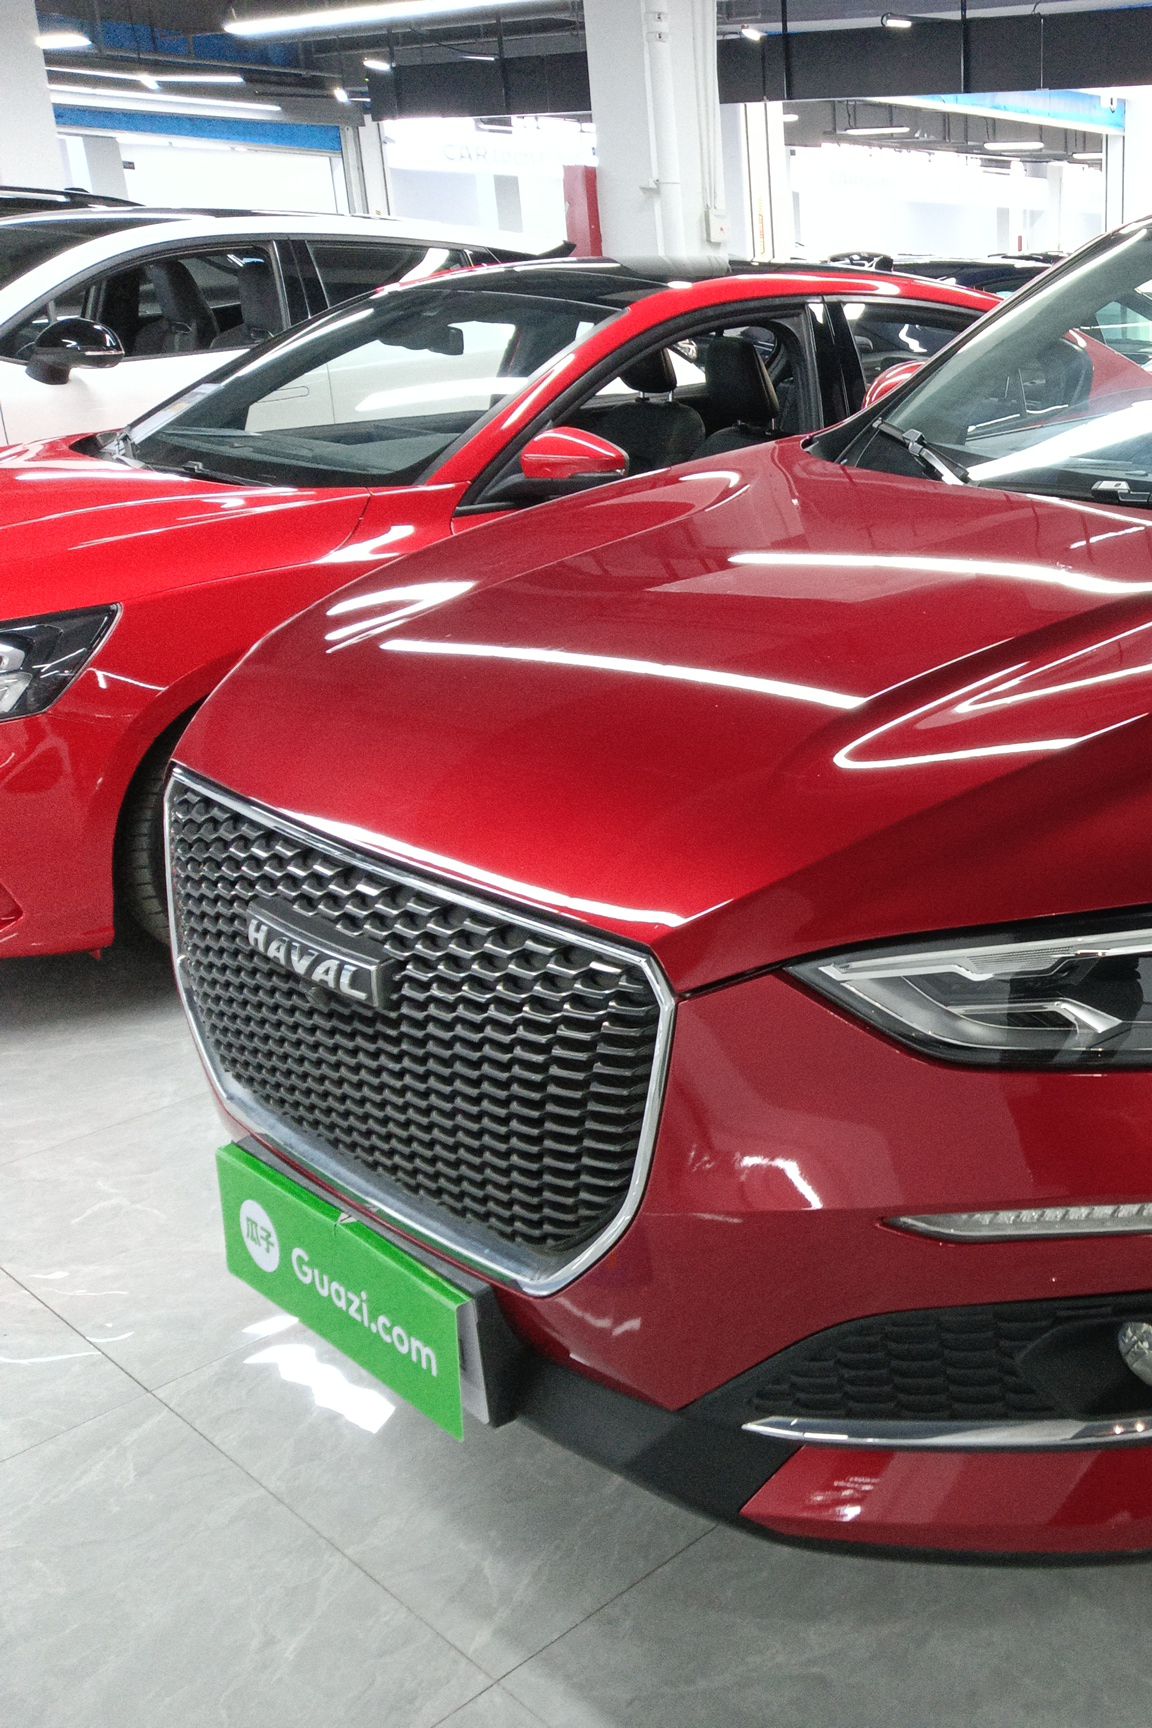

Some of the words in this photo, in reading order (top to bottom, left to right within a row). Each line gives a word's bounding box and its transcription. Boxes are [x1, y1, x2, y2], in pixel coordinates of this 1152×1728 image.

[248, 918, 368, 1001] HAVAL
[246, 1216, 275, 1254] 瓜子
[291, 1247, 438, 1377] Guazi.com
